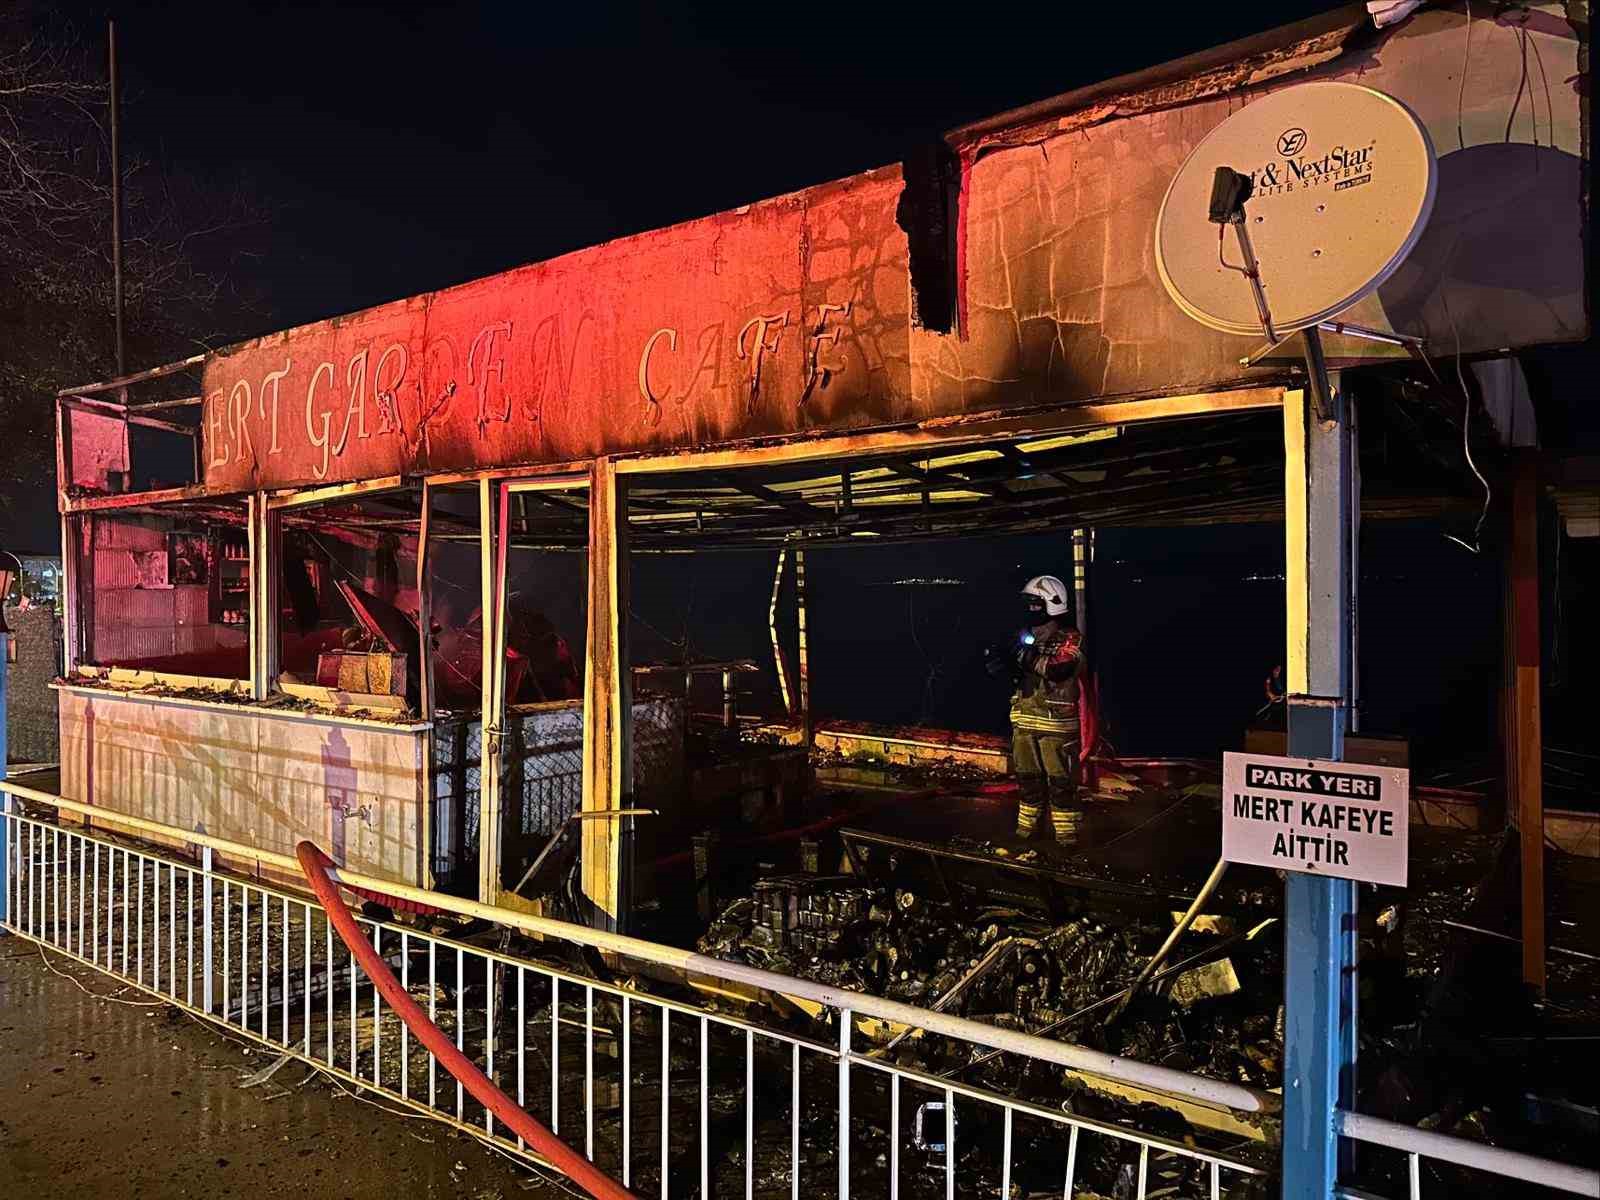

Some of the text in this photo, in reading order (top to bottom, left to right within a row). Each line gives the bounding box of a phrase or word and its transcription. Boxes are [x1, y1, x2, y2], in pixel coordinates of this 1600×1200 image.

[1260, 162, 1281, 187] &
[1303, 161, 1373, 188] SYSTEMS
[306, 308, 595, 479] GARDEN
[638, 302, 851, 418] CAFE
[1251, 768, 1313, 790] PARK
[1233, 794, 1393, 836] MERT KAFEYE
[1272, 828, 1349, 865] AİTTİR
